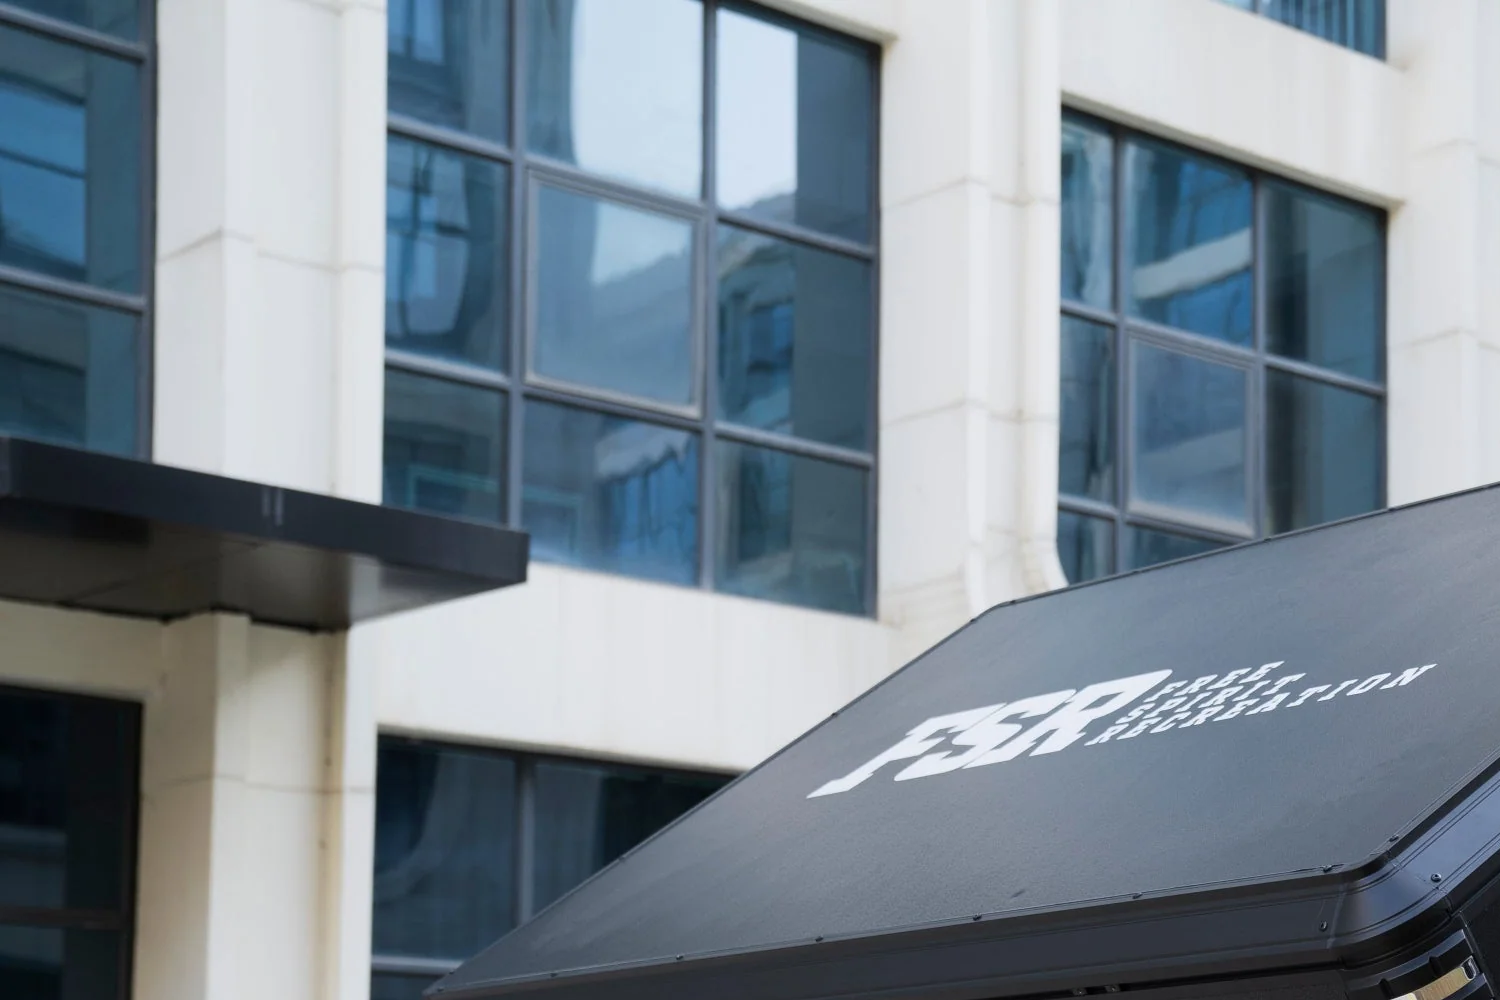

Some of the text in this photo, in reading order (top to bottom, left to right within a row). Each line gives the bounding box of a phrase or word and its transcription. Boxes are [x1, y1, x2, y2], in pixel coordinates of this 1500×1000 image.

[1084, 663, 1438, 746] RECREATION
[1115, 672, 1307, 725] SPIRIT
[1143, 660, 1286, 703] FREE
[806, 668, 1174, 799] FSR
